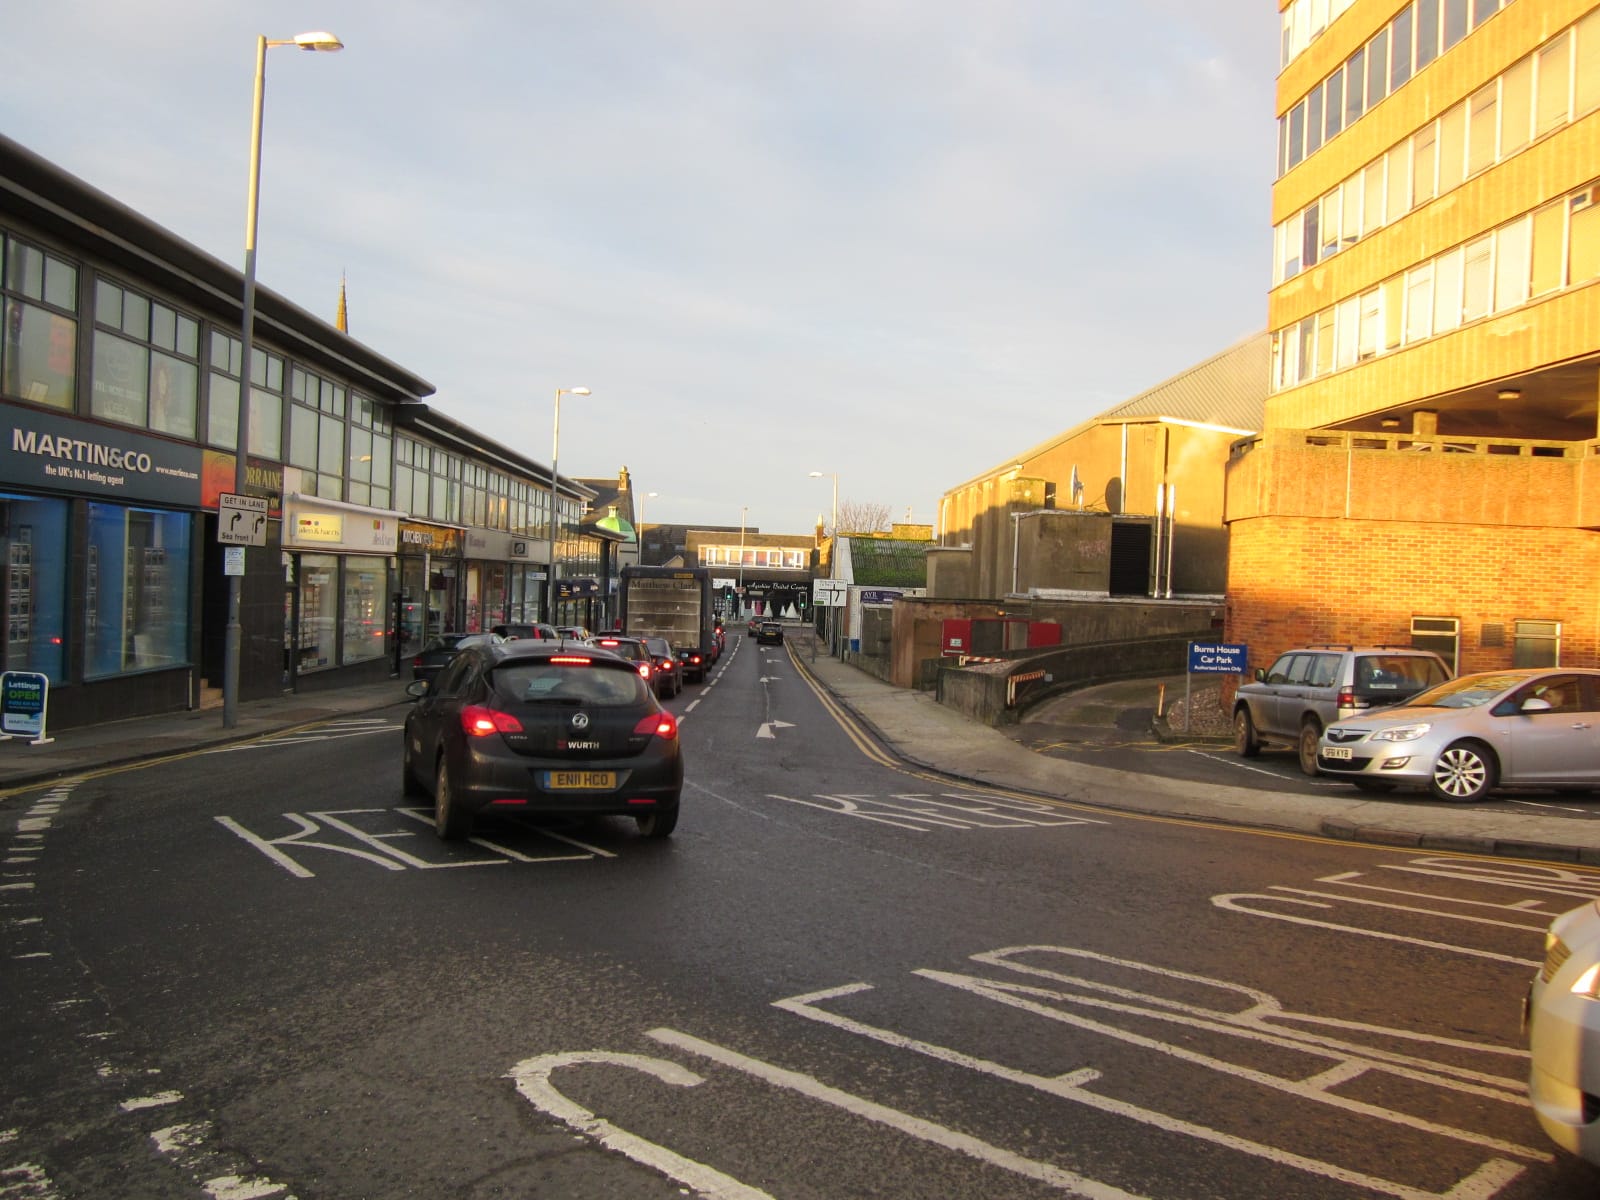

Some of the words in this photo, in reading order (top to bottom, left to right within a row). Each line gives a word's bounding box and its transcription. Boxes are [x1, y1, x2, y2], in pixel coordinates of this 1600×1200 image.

[12, 428, 151, 473] MARTIN&CO
[45, 464, 56, 476] the
[58, 466, 73, 477] UK's
[87, 470, 106, 484] letting
[107, 475, 124, 486] agent
[225, 496, 237, 505] GET
[248, 501, 265, 509] LANE
[221, 532, 233, 540] Sea
[234, 534, 249, 542] front
[631, 580, 668, 590] Matthew
[772, 582, 790, 591] Bridal
[1194, 644, 1215, 653] Burns
[1216, 646, 1240, 654] House
[1200, 655, 1215, 664] Car
[1216, 656, 1233, 664] Park
[8, 681, 41, 691] Lettings
[9, 690, 41, 700] OPEN
[767, 793, 1112, 831] KEEP
